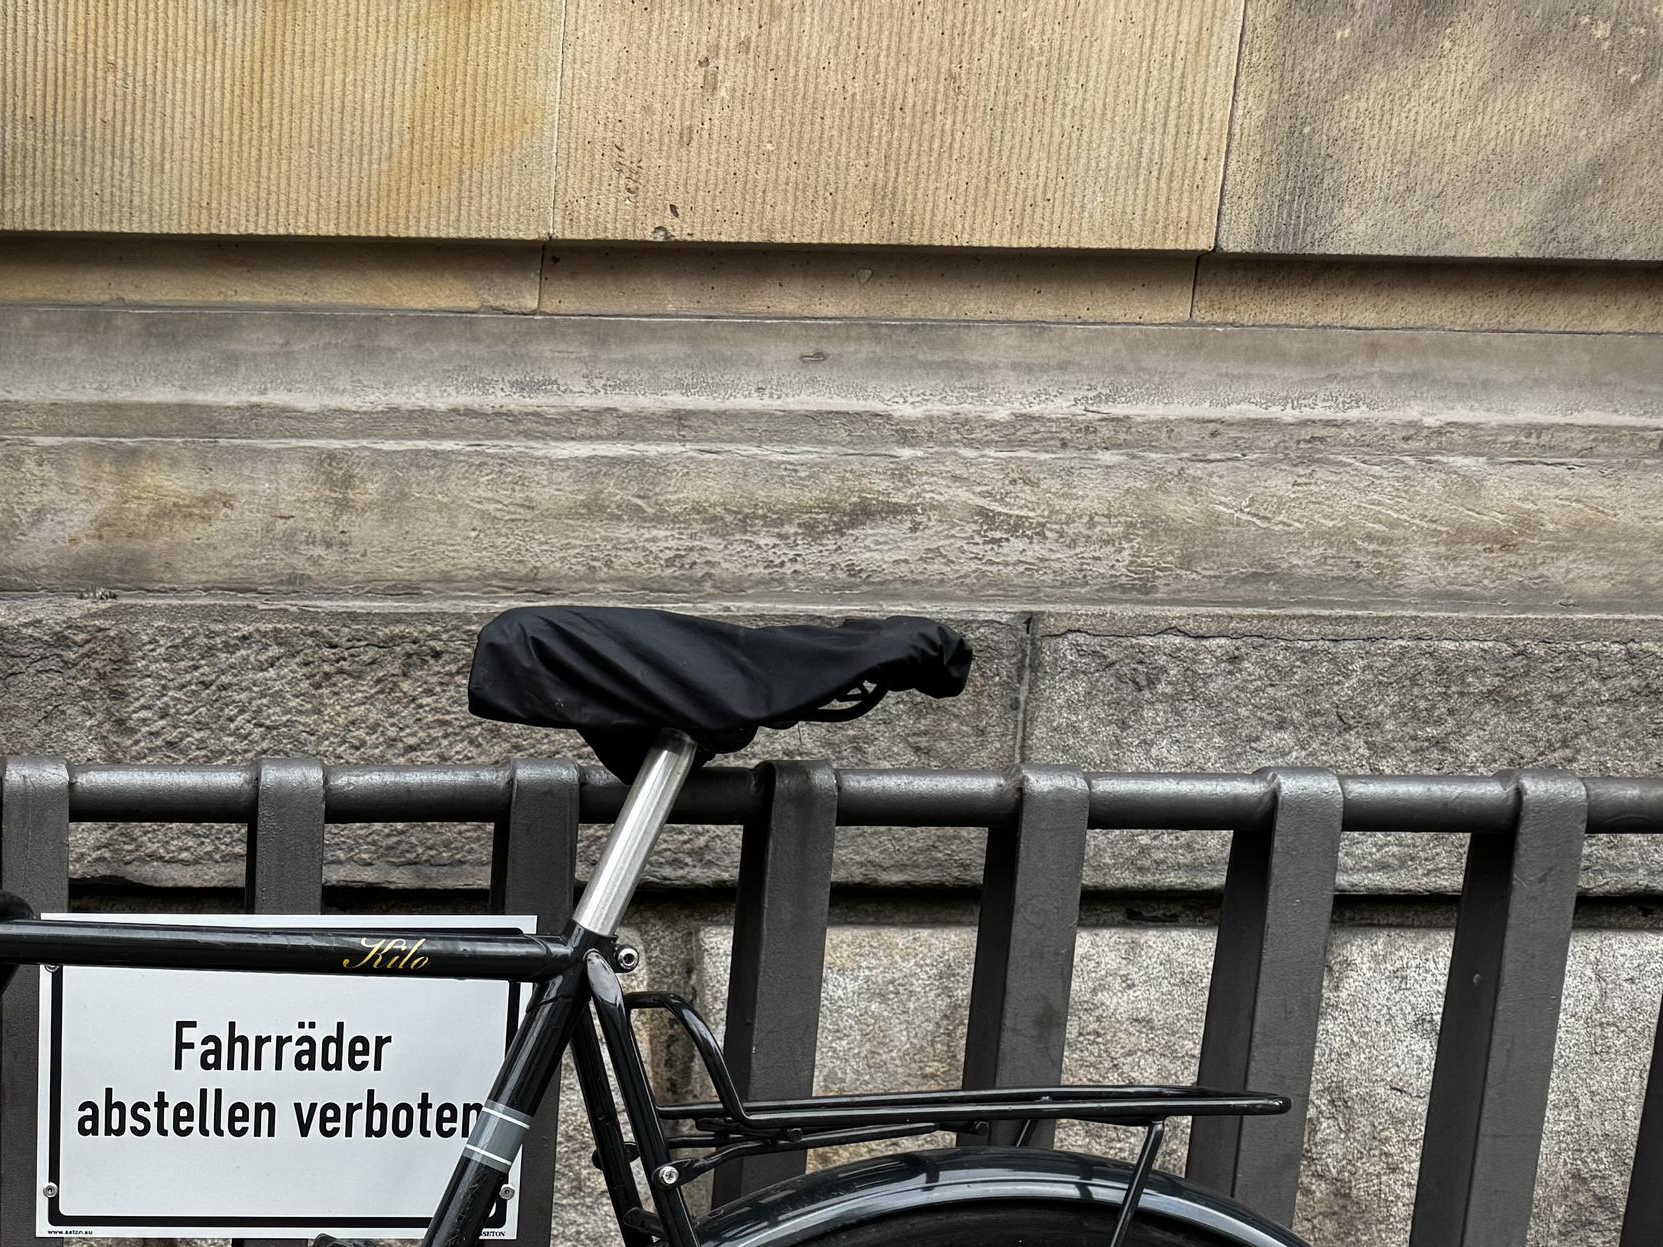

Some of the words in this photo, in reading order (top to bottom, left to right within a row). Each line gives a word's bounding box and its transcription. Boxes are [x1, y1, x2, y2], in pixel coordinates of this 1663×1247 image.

[174, 1020, 393, 1072] Fahrräder
[77, 1087, 277, 1138] abstellen
[294, 1089, 484, 1138] verboten
